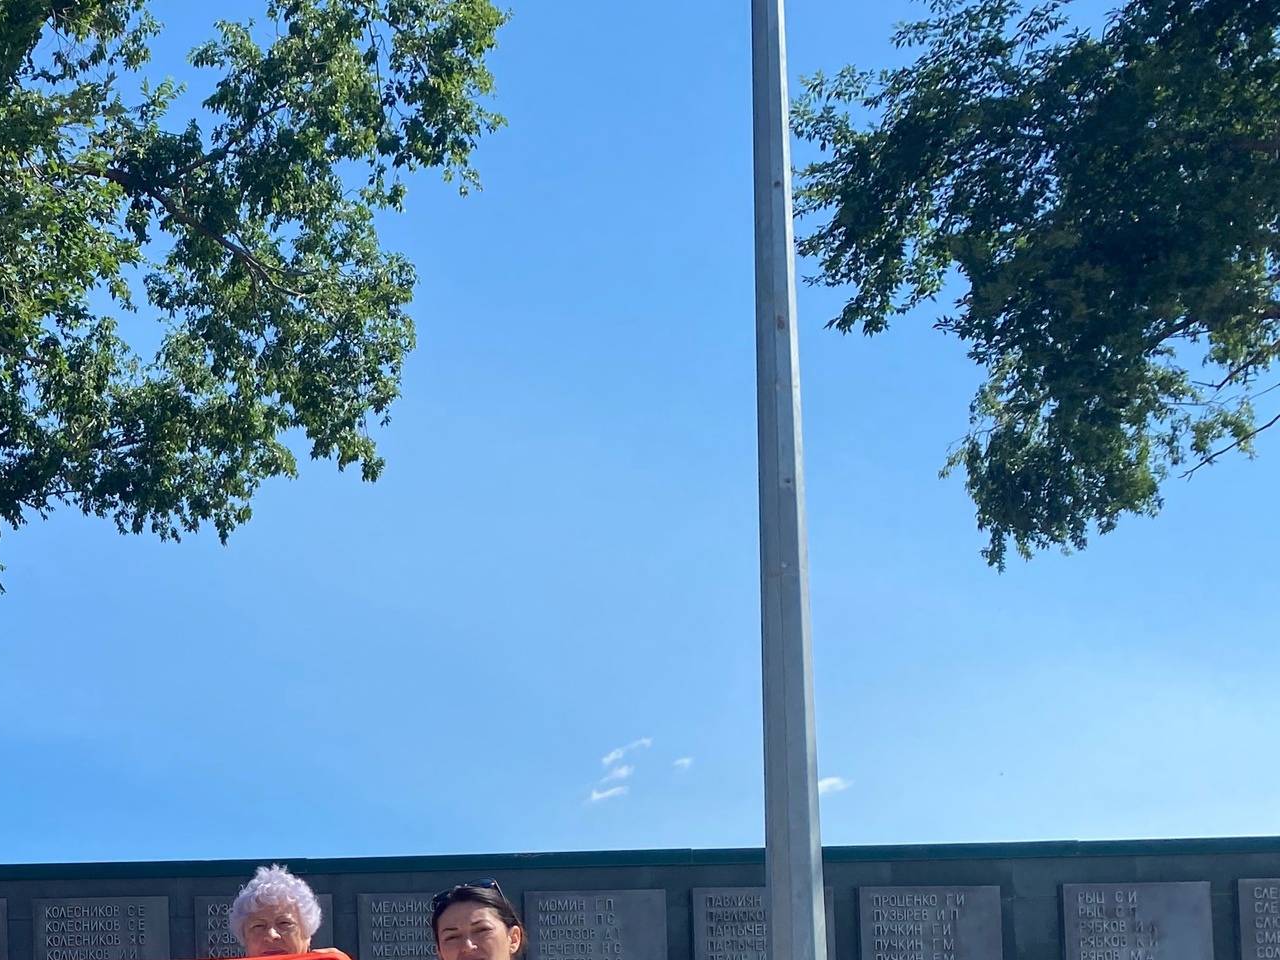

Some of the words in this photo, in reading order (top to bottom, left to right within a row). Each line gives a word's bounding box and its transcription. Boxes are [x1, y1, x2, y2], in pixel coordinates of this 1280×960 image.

[371, 901, 435, 912] МЕЛЬНИКО
[539, 899, 585, 912] МОМИН
[873, 894, 937, 907] ПРОЦЕНКО
[45, 906, 120, 918] КОЛЕСНИКОВ
[873, 909, 928, 922] ПУЗЫРЕВ
[45, 920, 120, 932] КОЛЕСНИКОВ
[539, 914, 585, 926] МОМИН
[875, 923, 922, 936] ПУЧКИН
[46, 934, 120, 946] КОЛЕСНИКОВ
[875, 939, 922, 951] ПУЧКИН
[47, 949, 110, 960] КОЛМЫКОВ
[372, 944, 438, 956] МЕЛЬНИКО
